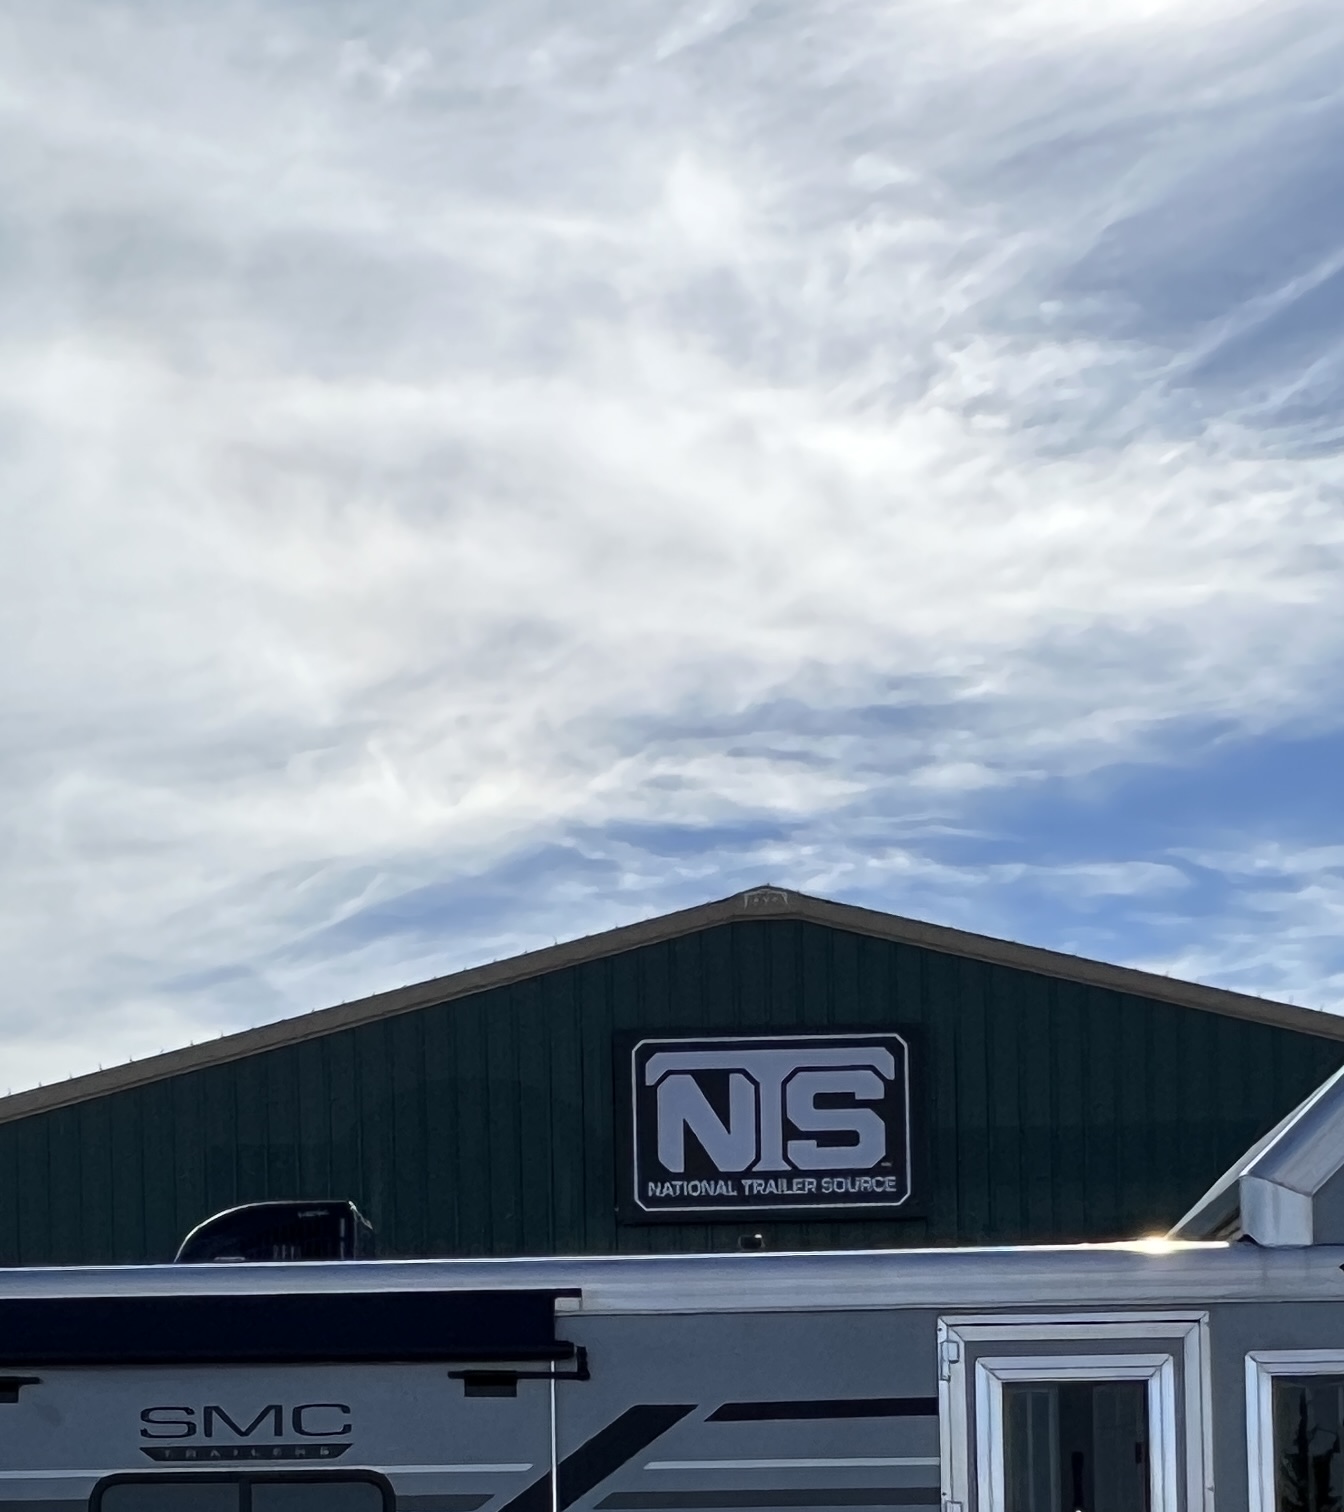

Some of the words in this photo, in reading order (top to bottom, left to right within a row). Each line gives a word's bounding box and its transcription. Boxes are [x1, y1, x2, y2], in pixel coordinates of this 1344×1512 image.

[644, 1046, 895, 1174] NTS
[647, 1178, 738, 1197] NATIONAL
[741, 1177, 816, 1196] TRAILER
[820, 1175, 898, 1194] SOURCE
[140, 1403, 352, 1439] SMC
